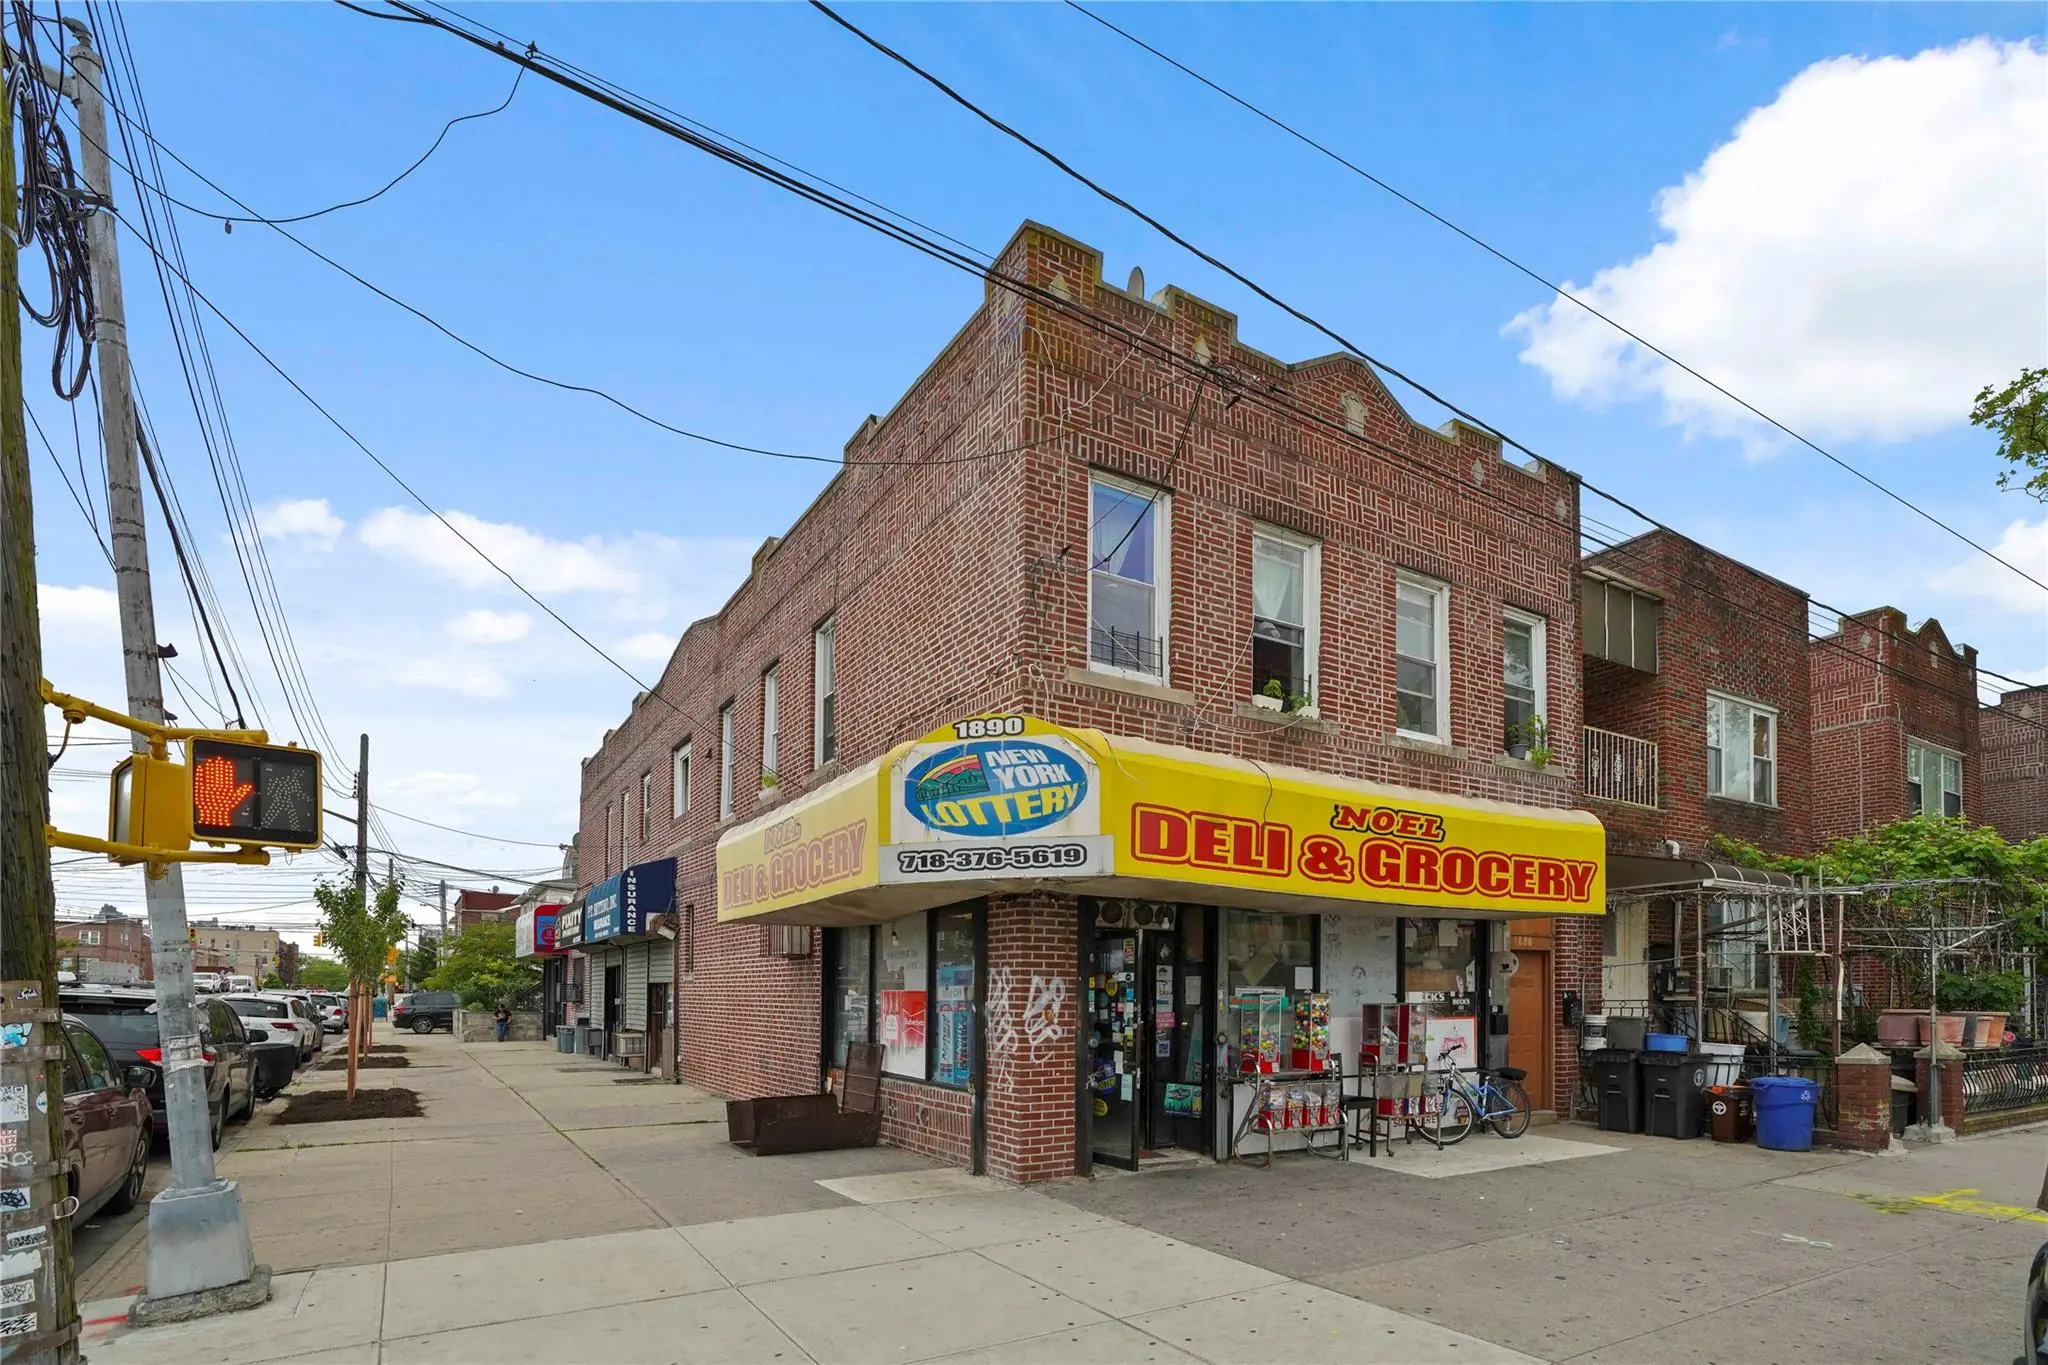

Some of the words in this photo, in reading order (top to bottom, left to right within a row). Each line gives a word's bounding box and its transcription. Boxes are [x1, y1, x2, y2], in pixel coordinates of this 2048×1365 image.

[953, 716, 1024, 739] 1890
[985, 749, 1049, 767] NEW
[992, 764, 1071, 790] YORK
[920, 783, 1079, 827] LOTTERY
[1331, 805, 1445, 842] NOEL
[723, 864, 753, 910] DELI
[755, 864, 769, 902] &
[771, 819, 867, 899] GROCERY
[900, 846, 1085, 872] 718-376-5619
[1131, 802, 1292, 877] DELI
[1298, 834, 1354, 883] &
[1359, 837, 1597, 903] GROCERY
[627, 870, 636, 933] INSURANCE
